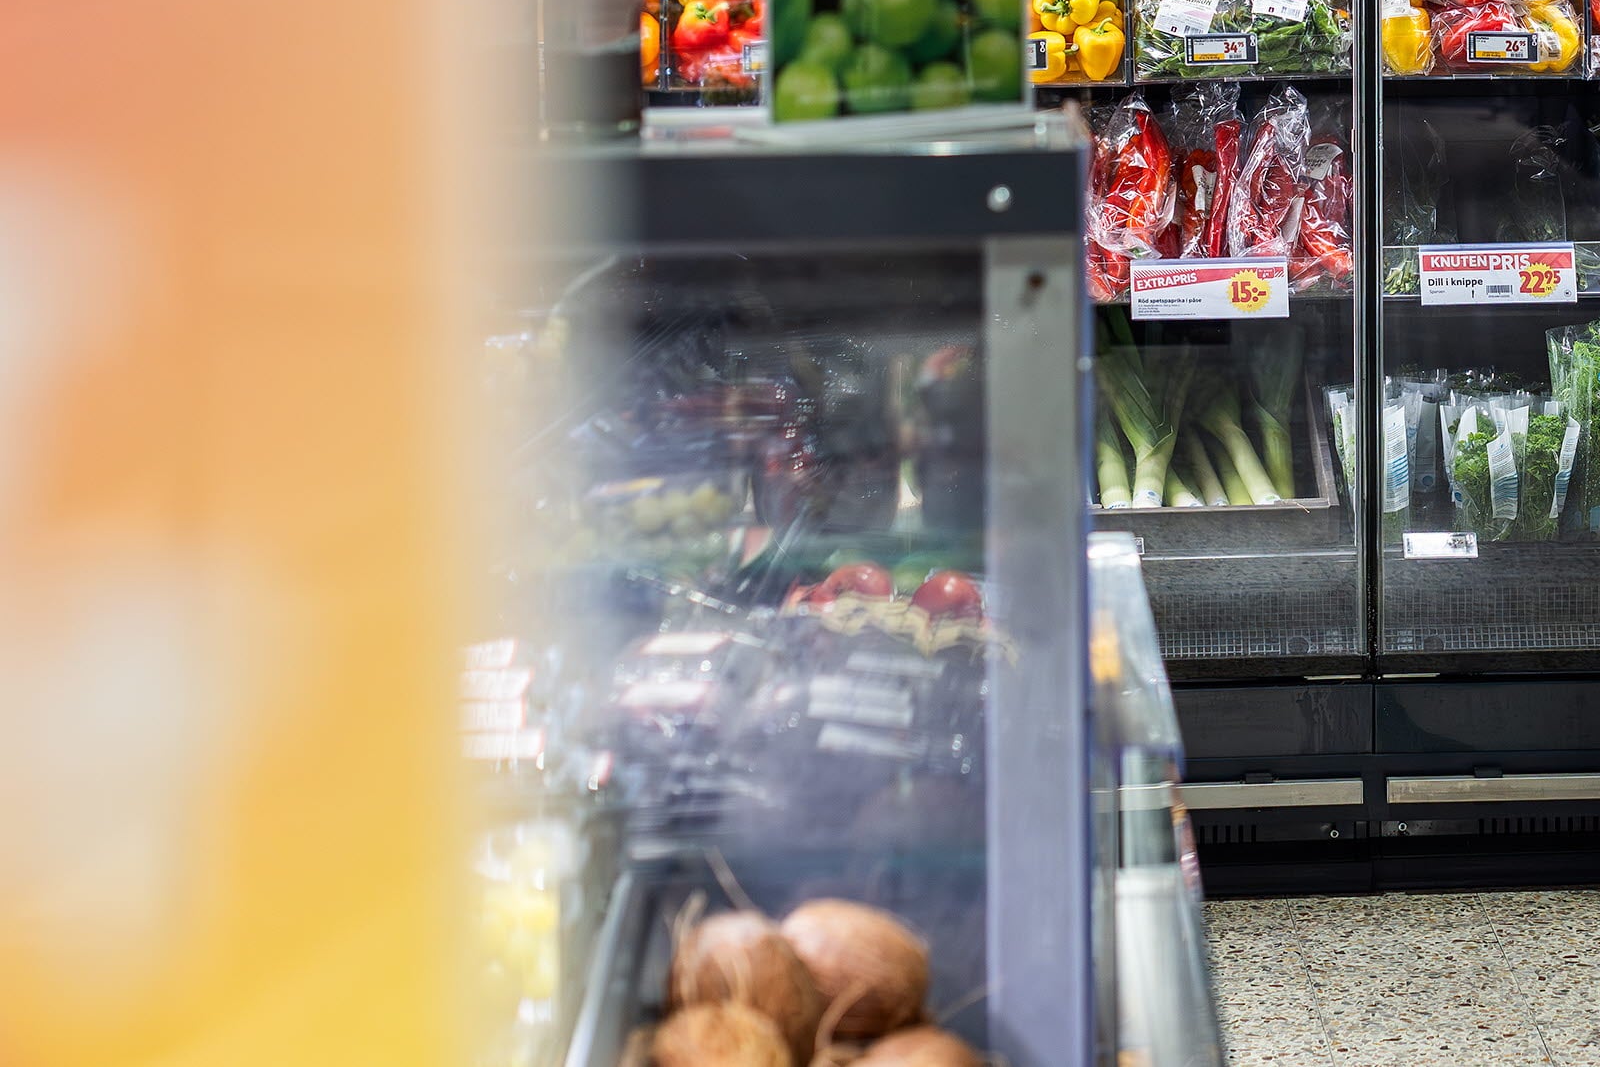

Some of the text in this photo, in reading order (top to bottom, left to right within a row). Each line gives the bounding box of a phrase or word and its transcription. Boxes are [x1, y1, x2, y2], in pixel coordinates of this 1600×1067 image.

[1136, 272, 1198, 290] EXTRAPRIS
[1428, 278, 1444, 286] Dill
[1451, 277, 1483, 287] knippe
